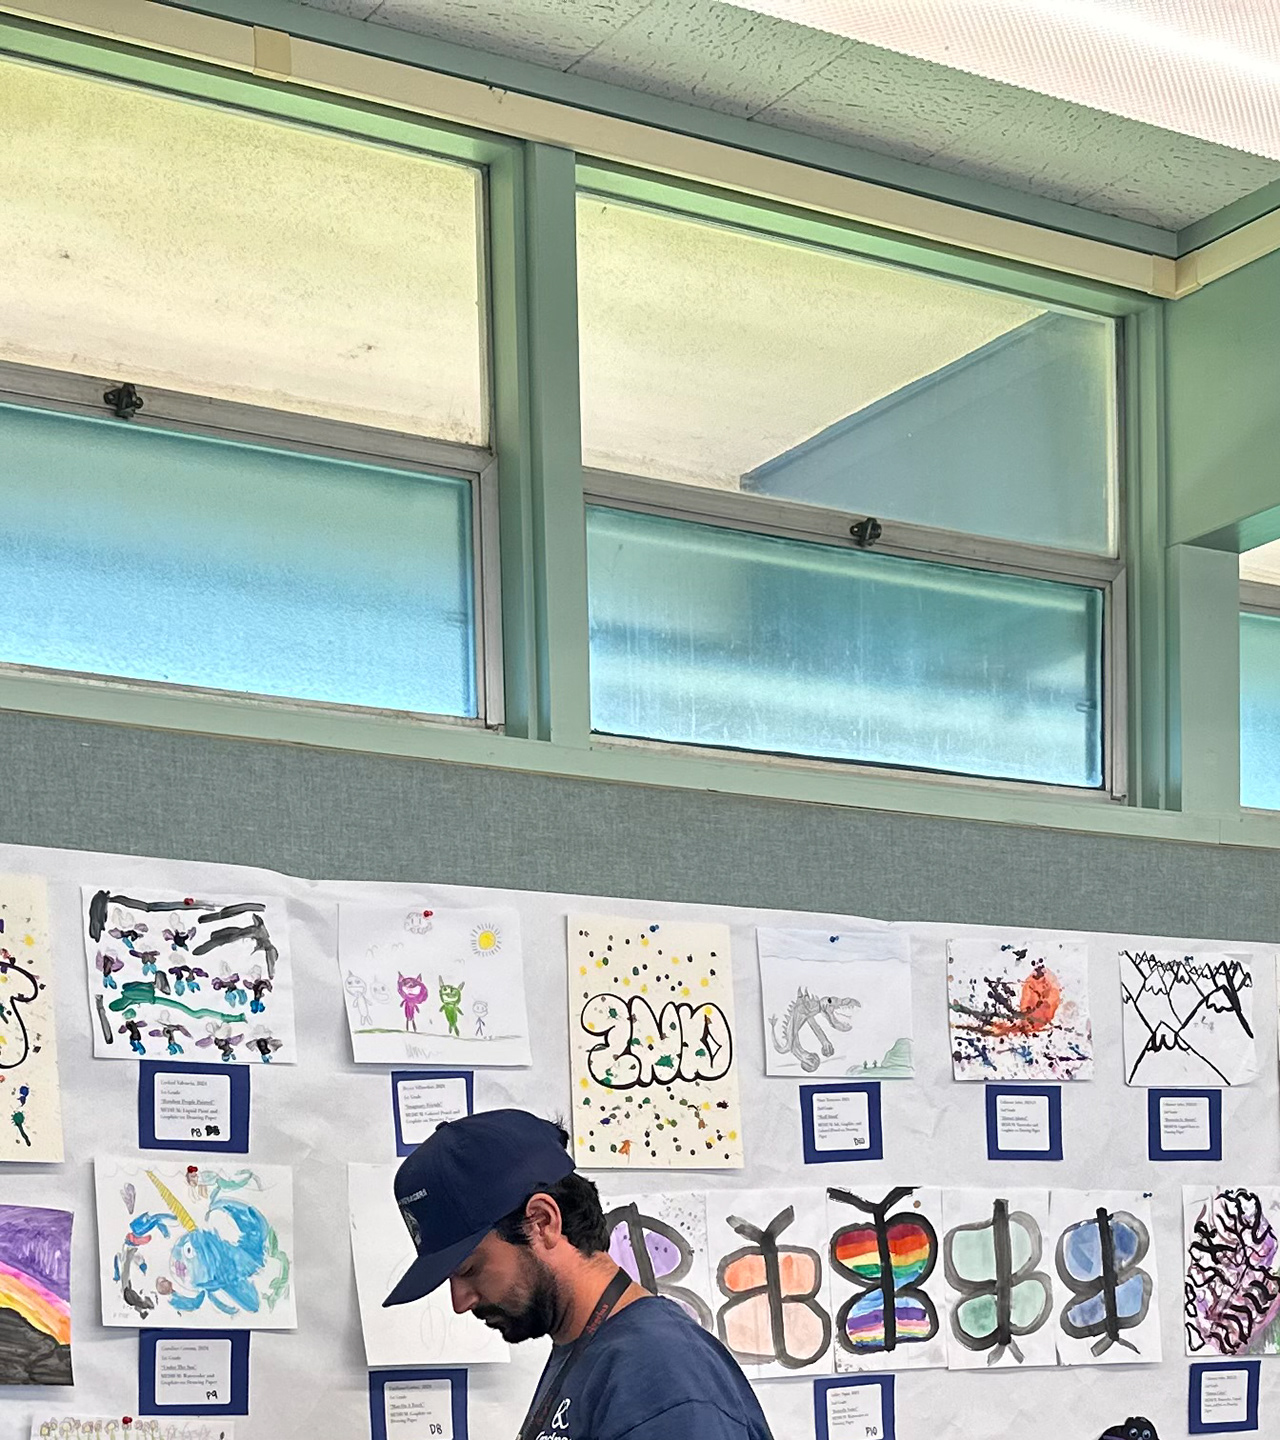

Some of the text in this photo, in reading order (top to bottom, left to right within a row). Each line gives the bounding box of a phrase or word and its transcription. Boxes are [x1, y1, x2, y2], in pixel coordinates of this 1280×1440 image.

[581, 994, 734, 1090] 2ND
[191, 1128, 202, 1137] P8
[206, 1390, 218, 1400] P9
[429, 1423, 443, 1435] D8
